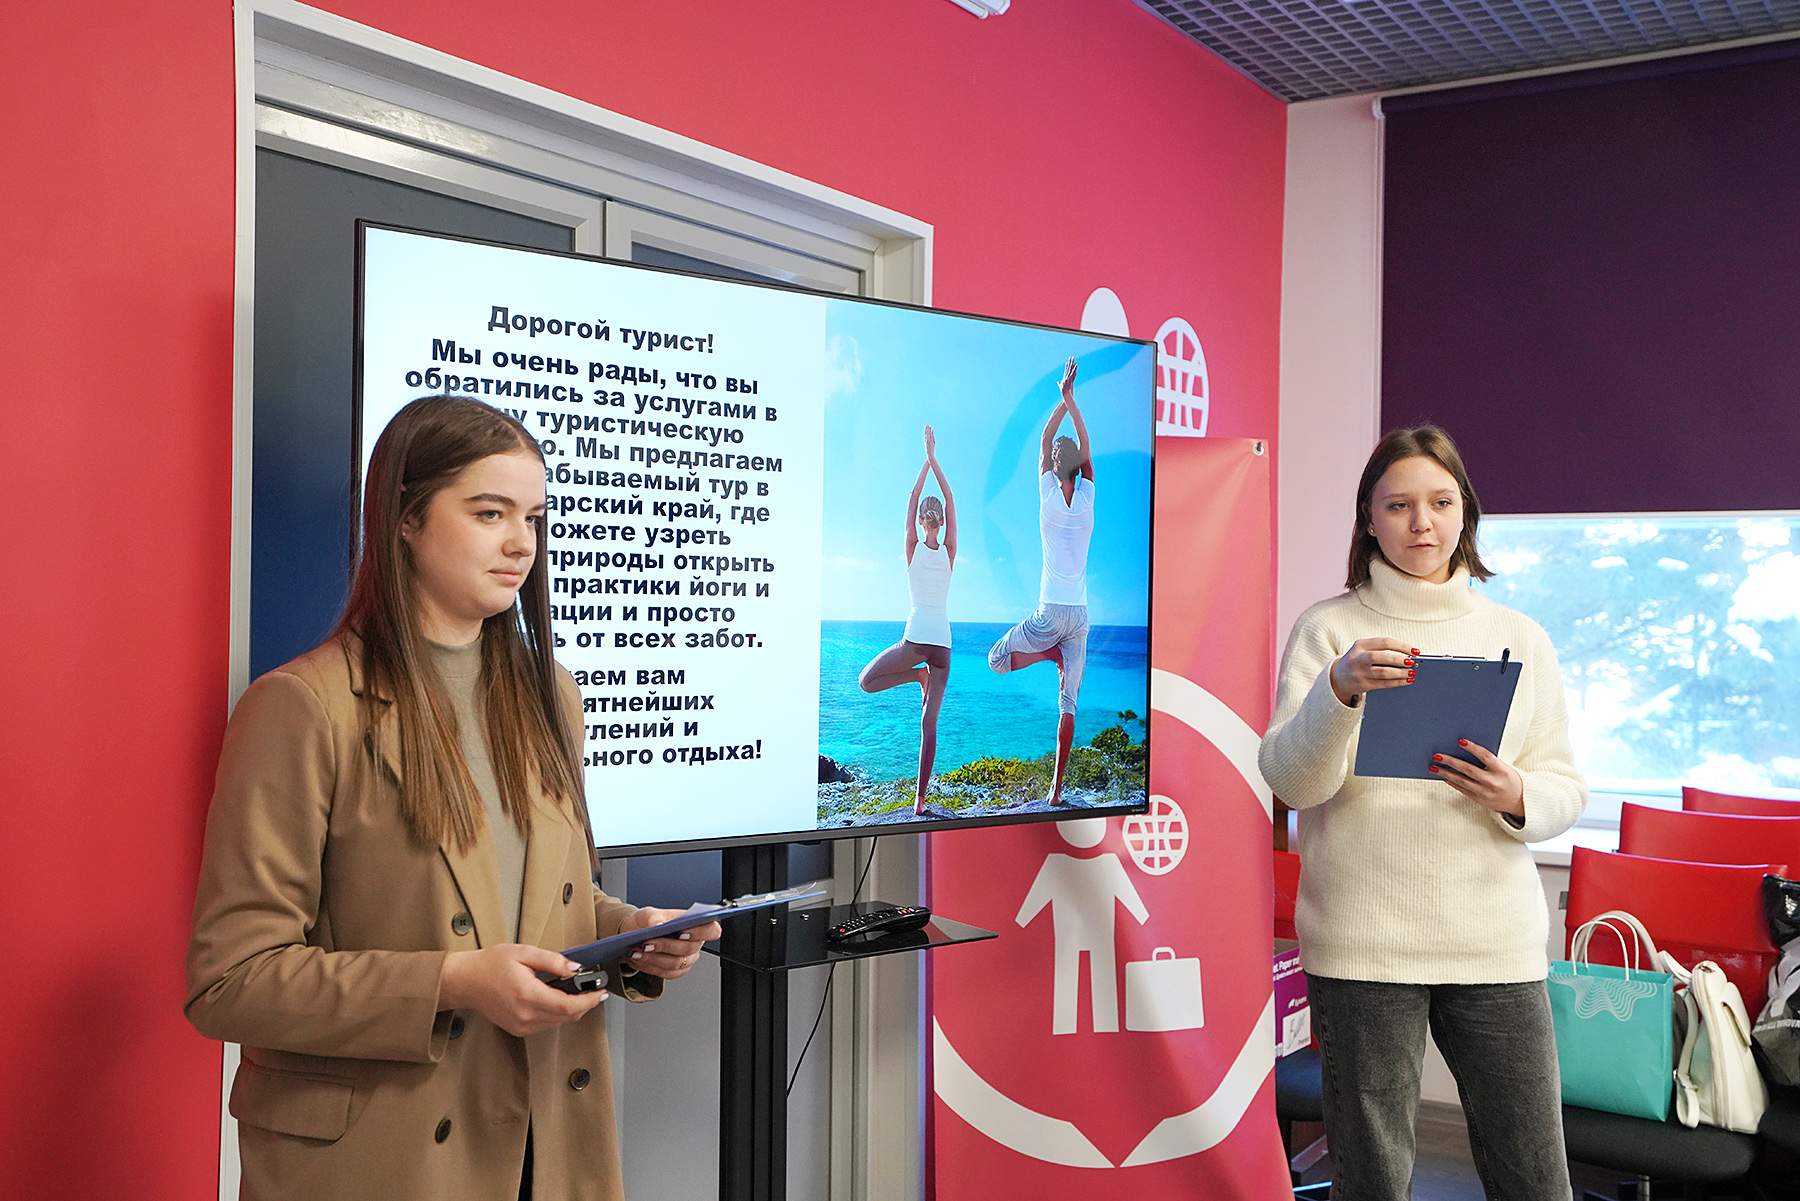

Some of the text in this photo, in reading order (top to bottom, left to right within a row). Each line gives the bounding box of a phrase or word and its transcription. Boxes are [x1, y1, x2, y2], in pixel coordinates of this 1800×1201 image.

[488, 306, 713, 353] Дорогой турист!
[433, 339, 757, 394] Мы очень рады, что вы
[405, 368, 777, 421] обратились за услугами в
[537, 411, 744, 444] туристическую
[576, 437, 619, 460] Мы
[630, 447, 782, 472] предлагаем
[546, 463, 768, 500] абываемый тур в
[547, 494, 769, 525] арский край, где
[551, 523, 730, 548] ожете узреть
[674, 555, 774, 576] открыть
[554, 576, 768, 598] практики йоги и
[550, 605, 735, 627] ации и просто
[577, 633, 605, 647] от
[615, 633, 675, 647] всех
[685, 628, 762, 647] забот.
[569, 669, 684, 686] аем вам
[583, 691, 715, 712] ятнейших
[684, 722, 698, 736] и
[663, 740, 761, 766] отдыха!
